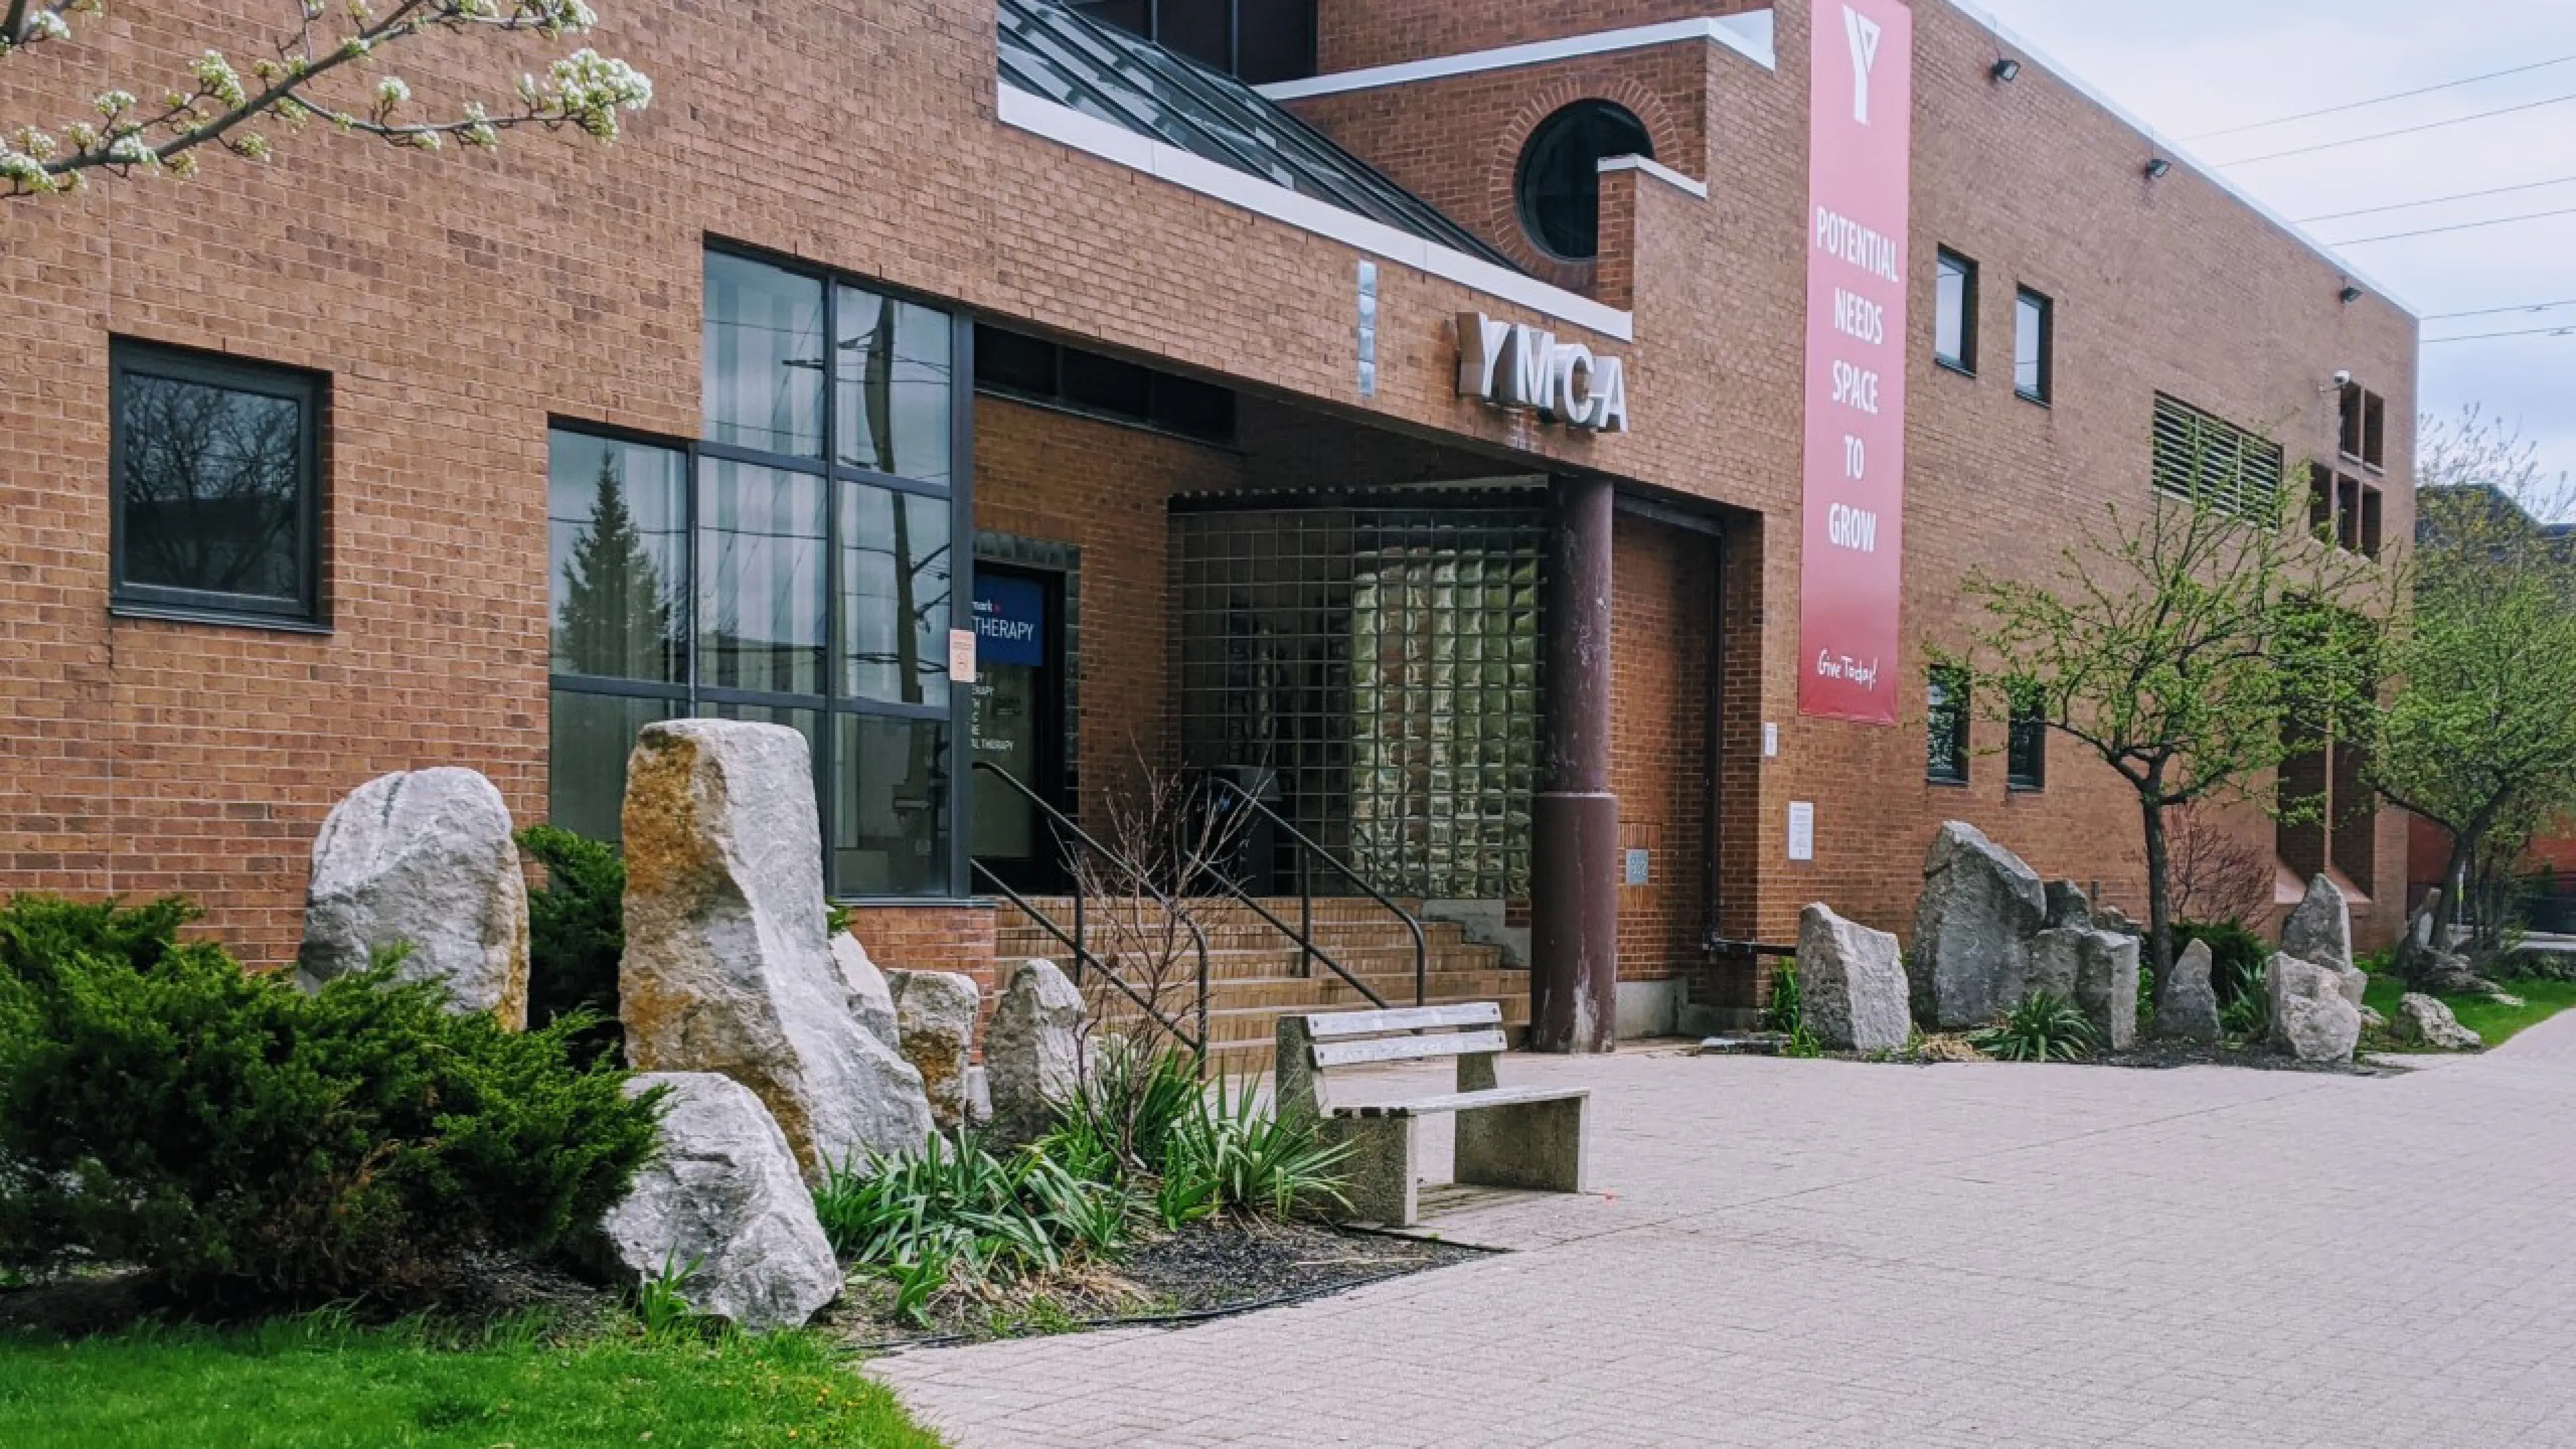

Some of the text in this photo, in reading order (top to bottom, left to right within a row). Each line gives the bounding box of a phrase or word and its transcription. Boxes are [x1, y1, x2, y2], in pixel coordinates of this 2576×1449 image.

[1817, 205, 1898, 282] POTENTIAL
[1834, 286, 1883, 345] NEEDS
[1478, 311, 1629, 433] YMCA
[1832, 360, 1878, 415] SPACE
[1843, 434, 1864, 480] TO
[1829, 502, 1876, 552] GROW
[1817, 648, 1878, 692] Give Today!
